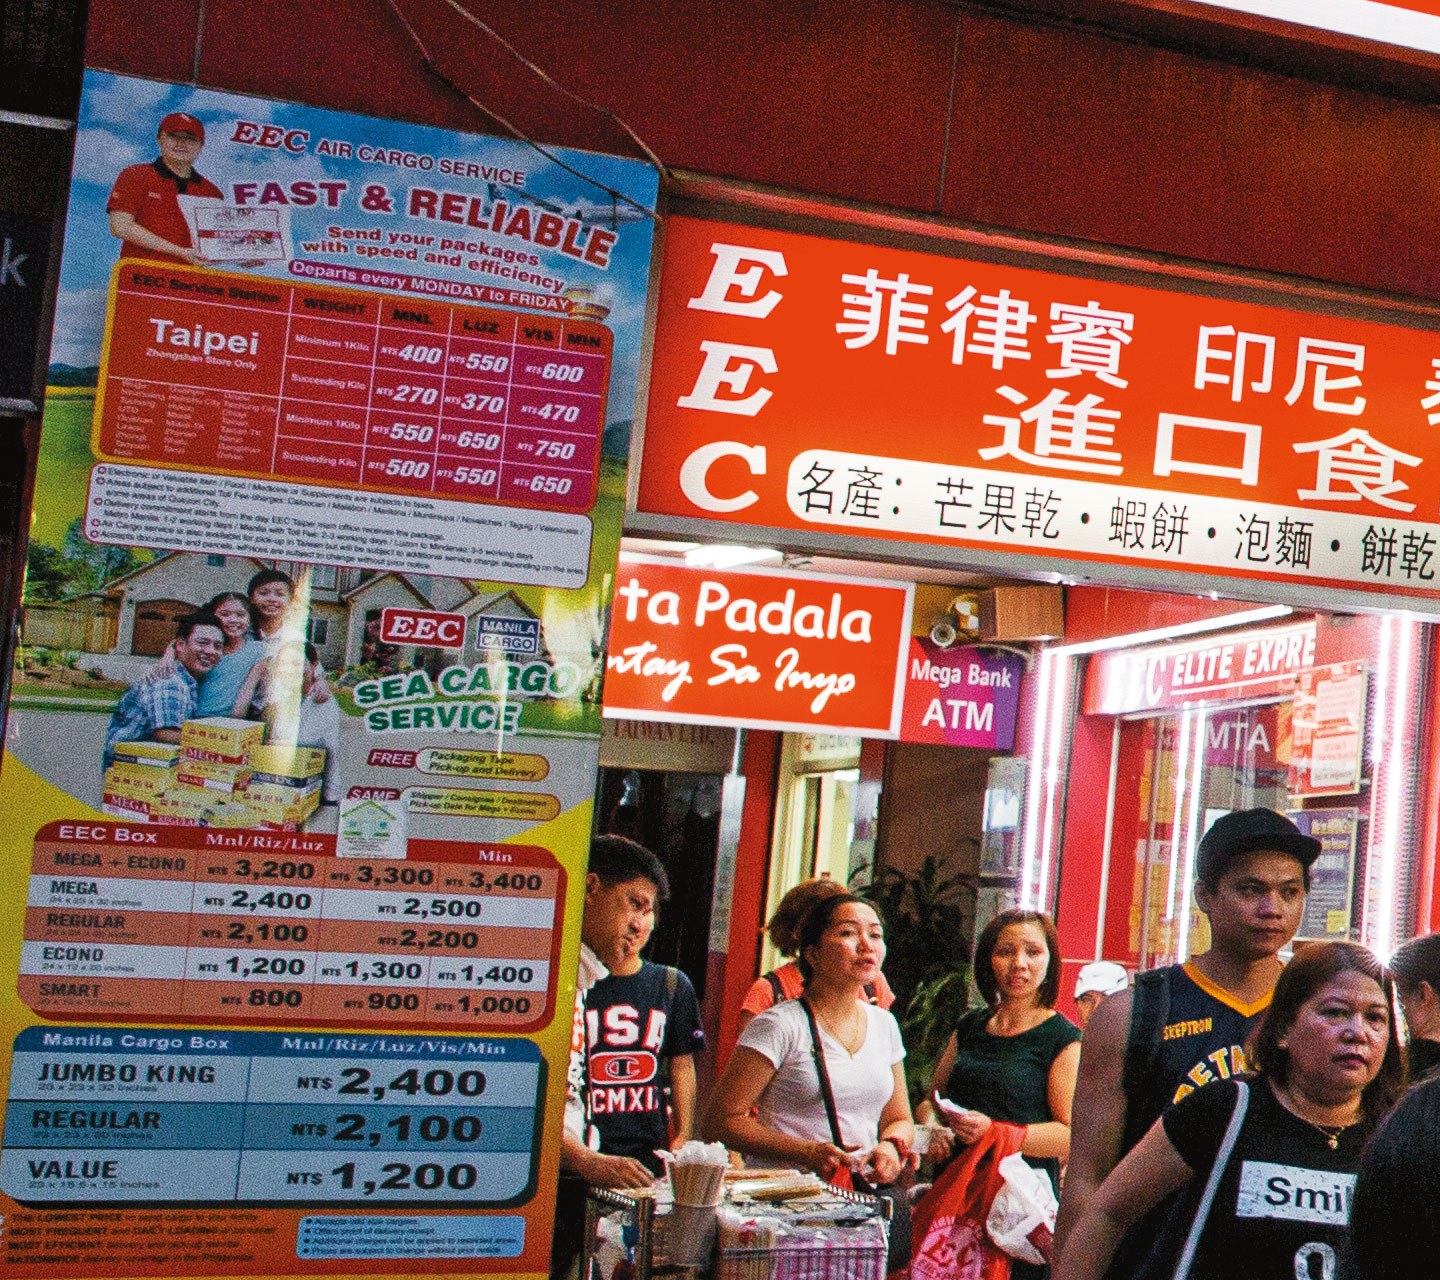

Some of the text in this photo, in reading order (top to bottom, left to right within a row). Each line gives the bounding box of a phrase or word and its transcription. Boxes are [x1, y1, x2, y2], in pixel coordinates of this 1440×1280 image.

[231, 121, 526, 185] EEC AIR CARGO SERVICE
[234, 182, 617, 268] FAST & RELIABLE
[328, 225, 539, 266] Send your packages
[301, 239, 565, 294] with speed and efficiency
[291, 260, 570, 312] Departs every MONDAY FRIDAY
[150, 317, 260, 356] Taipei
[835, 269, 1135, 390] 菲律賓
[1194, 324, 1367, 416] 印尼
[388, 616, 460, 642] EEC
[482, 621, 536, 635] MANILA
[619, 578, 873, 644] ta Padala
[482, 634, 534, 649] CARGO
[356, 662, 579, 703] SEA CARGO
[708, 643, 761, 686] Sa
[911, 659, 1012, 689] Mega Bank
[1172, 646, 1233, 687] ELITE
[368, 703, 518, 733] SERVICE
[921, 699, 994, 732] ATM
[371, 751, 414, 766] FREE
[59, 825, 513, 863] EEC Box Min
[127, 855, 542, 892] ECONO 3,200 3,300 3,400
[51, 880, 481, 919] MEGA 2,400 2,500
[227, 923, 478, 950] 2,100 2,200
[43, 947, 534, 985] ECONO 1,200 1,300 1,400
[248, 989, 530, 1016] 800 900 1,000
[43, 1032, 229, 1050] Manila Cargo Box
[1162, 1014, 1214, 1041] SKEPTRON
[37, 1062, 487, 1101] JUMBO KING 2,400
[31, 1110, 482, 1148] REGULAR 2,100
[28, 1160, 479, 1195] VALUE 1,200
